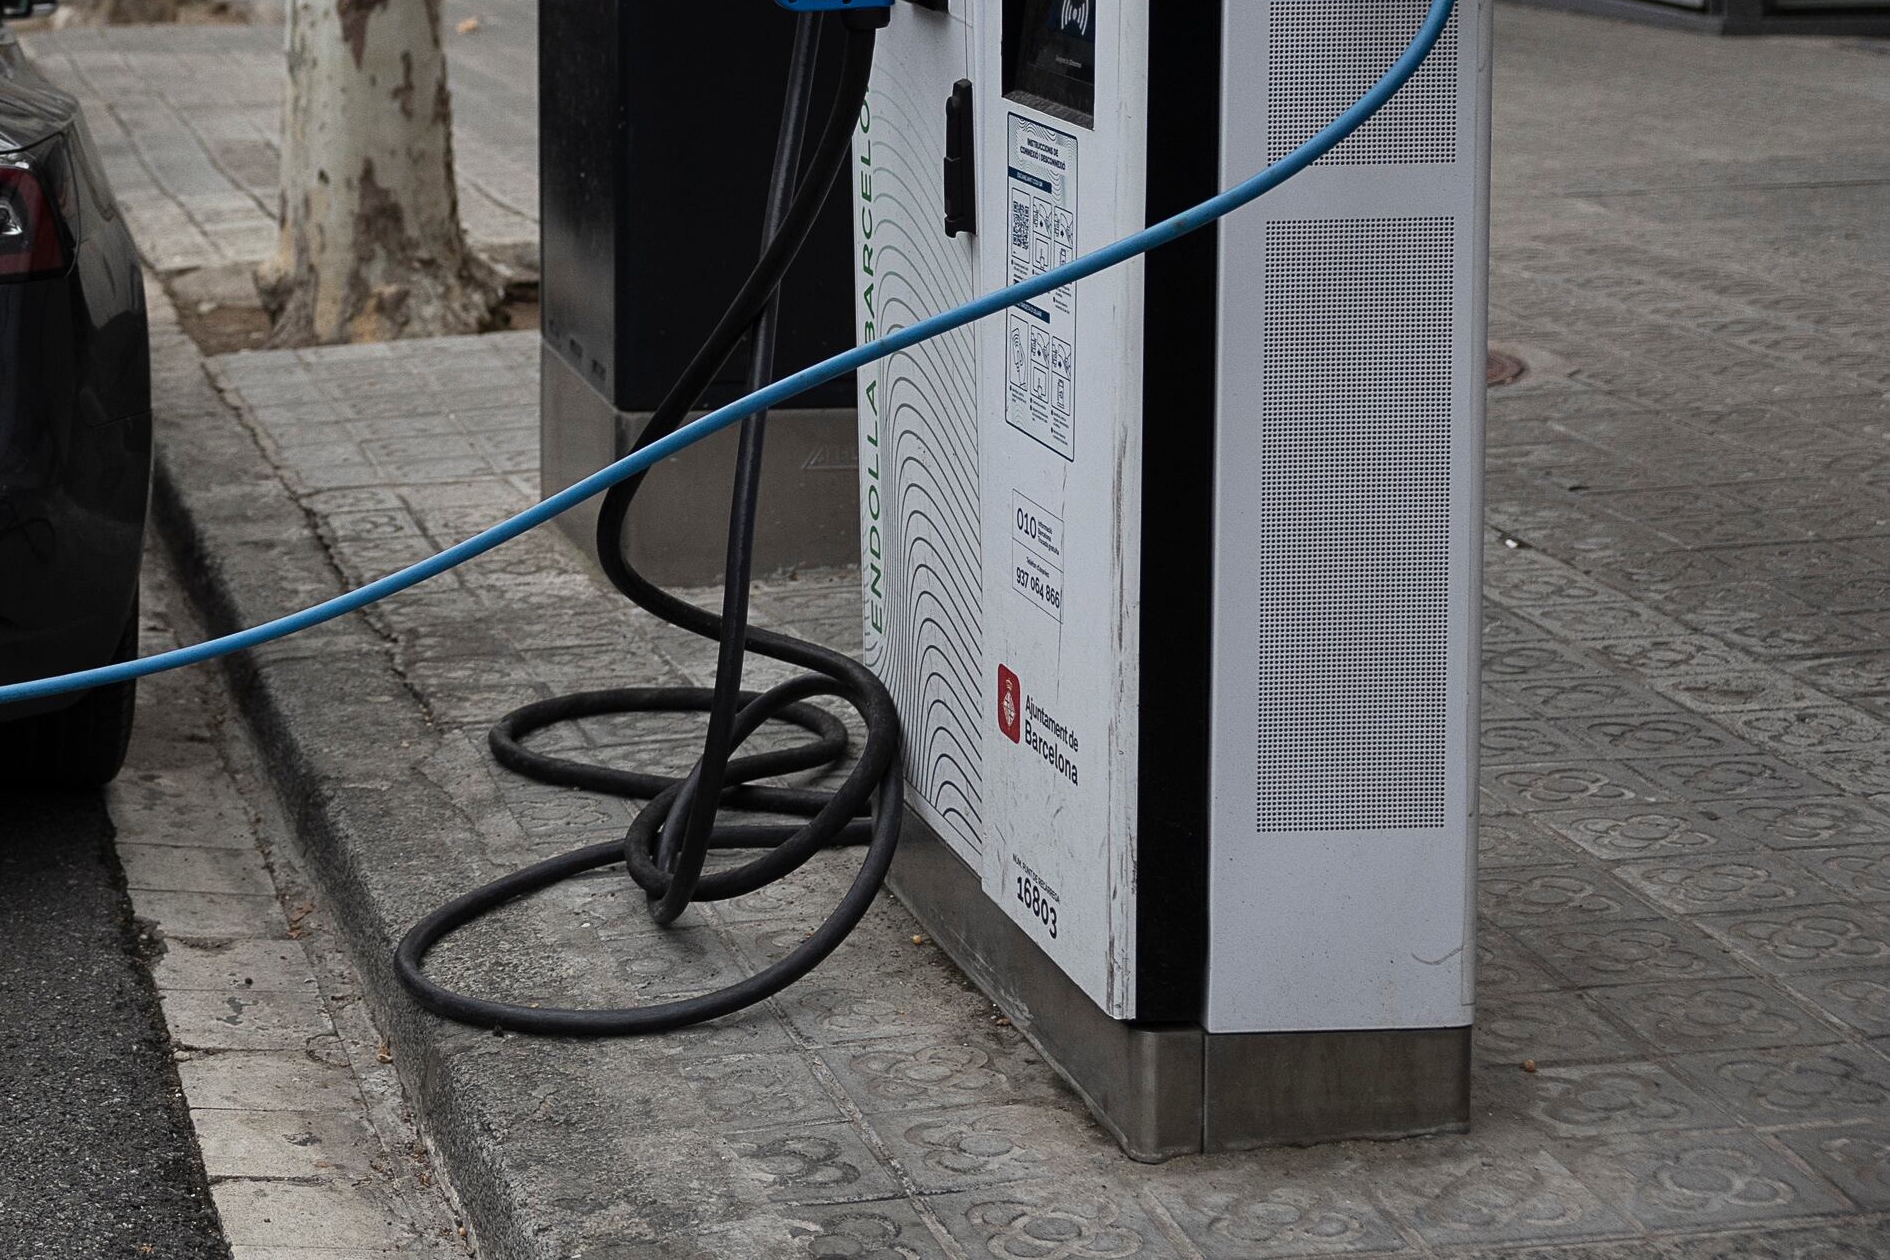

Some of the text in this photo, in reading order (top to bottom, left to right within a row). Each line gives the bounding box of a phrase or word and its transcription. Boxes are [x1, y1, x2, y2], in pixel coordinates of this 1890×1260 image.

[866, 379, 883, 634] ENDOLLA
[1017, 508, 1036, 539] 010
[1016, 567, 1060, 608] 937 064 866
[1025, 694, 1078, 752] Ajuntament de
[1025, 719, 1078, 786] Barcelona
[1017, 876, 1057, 939] 16803
